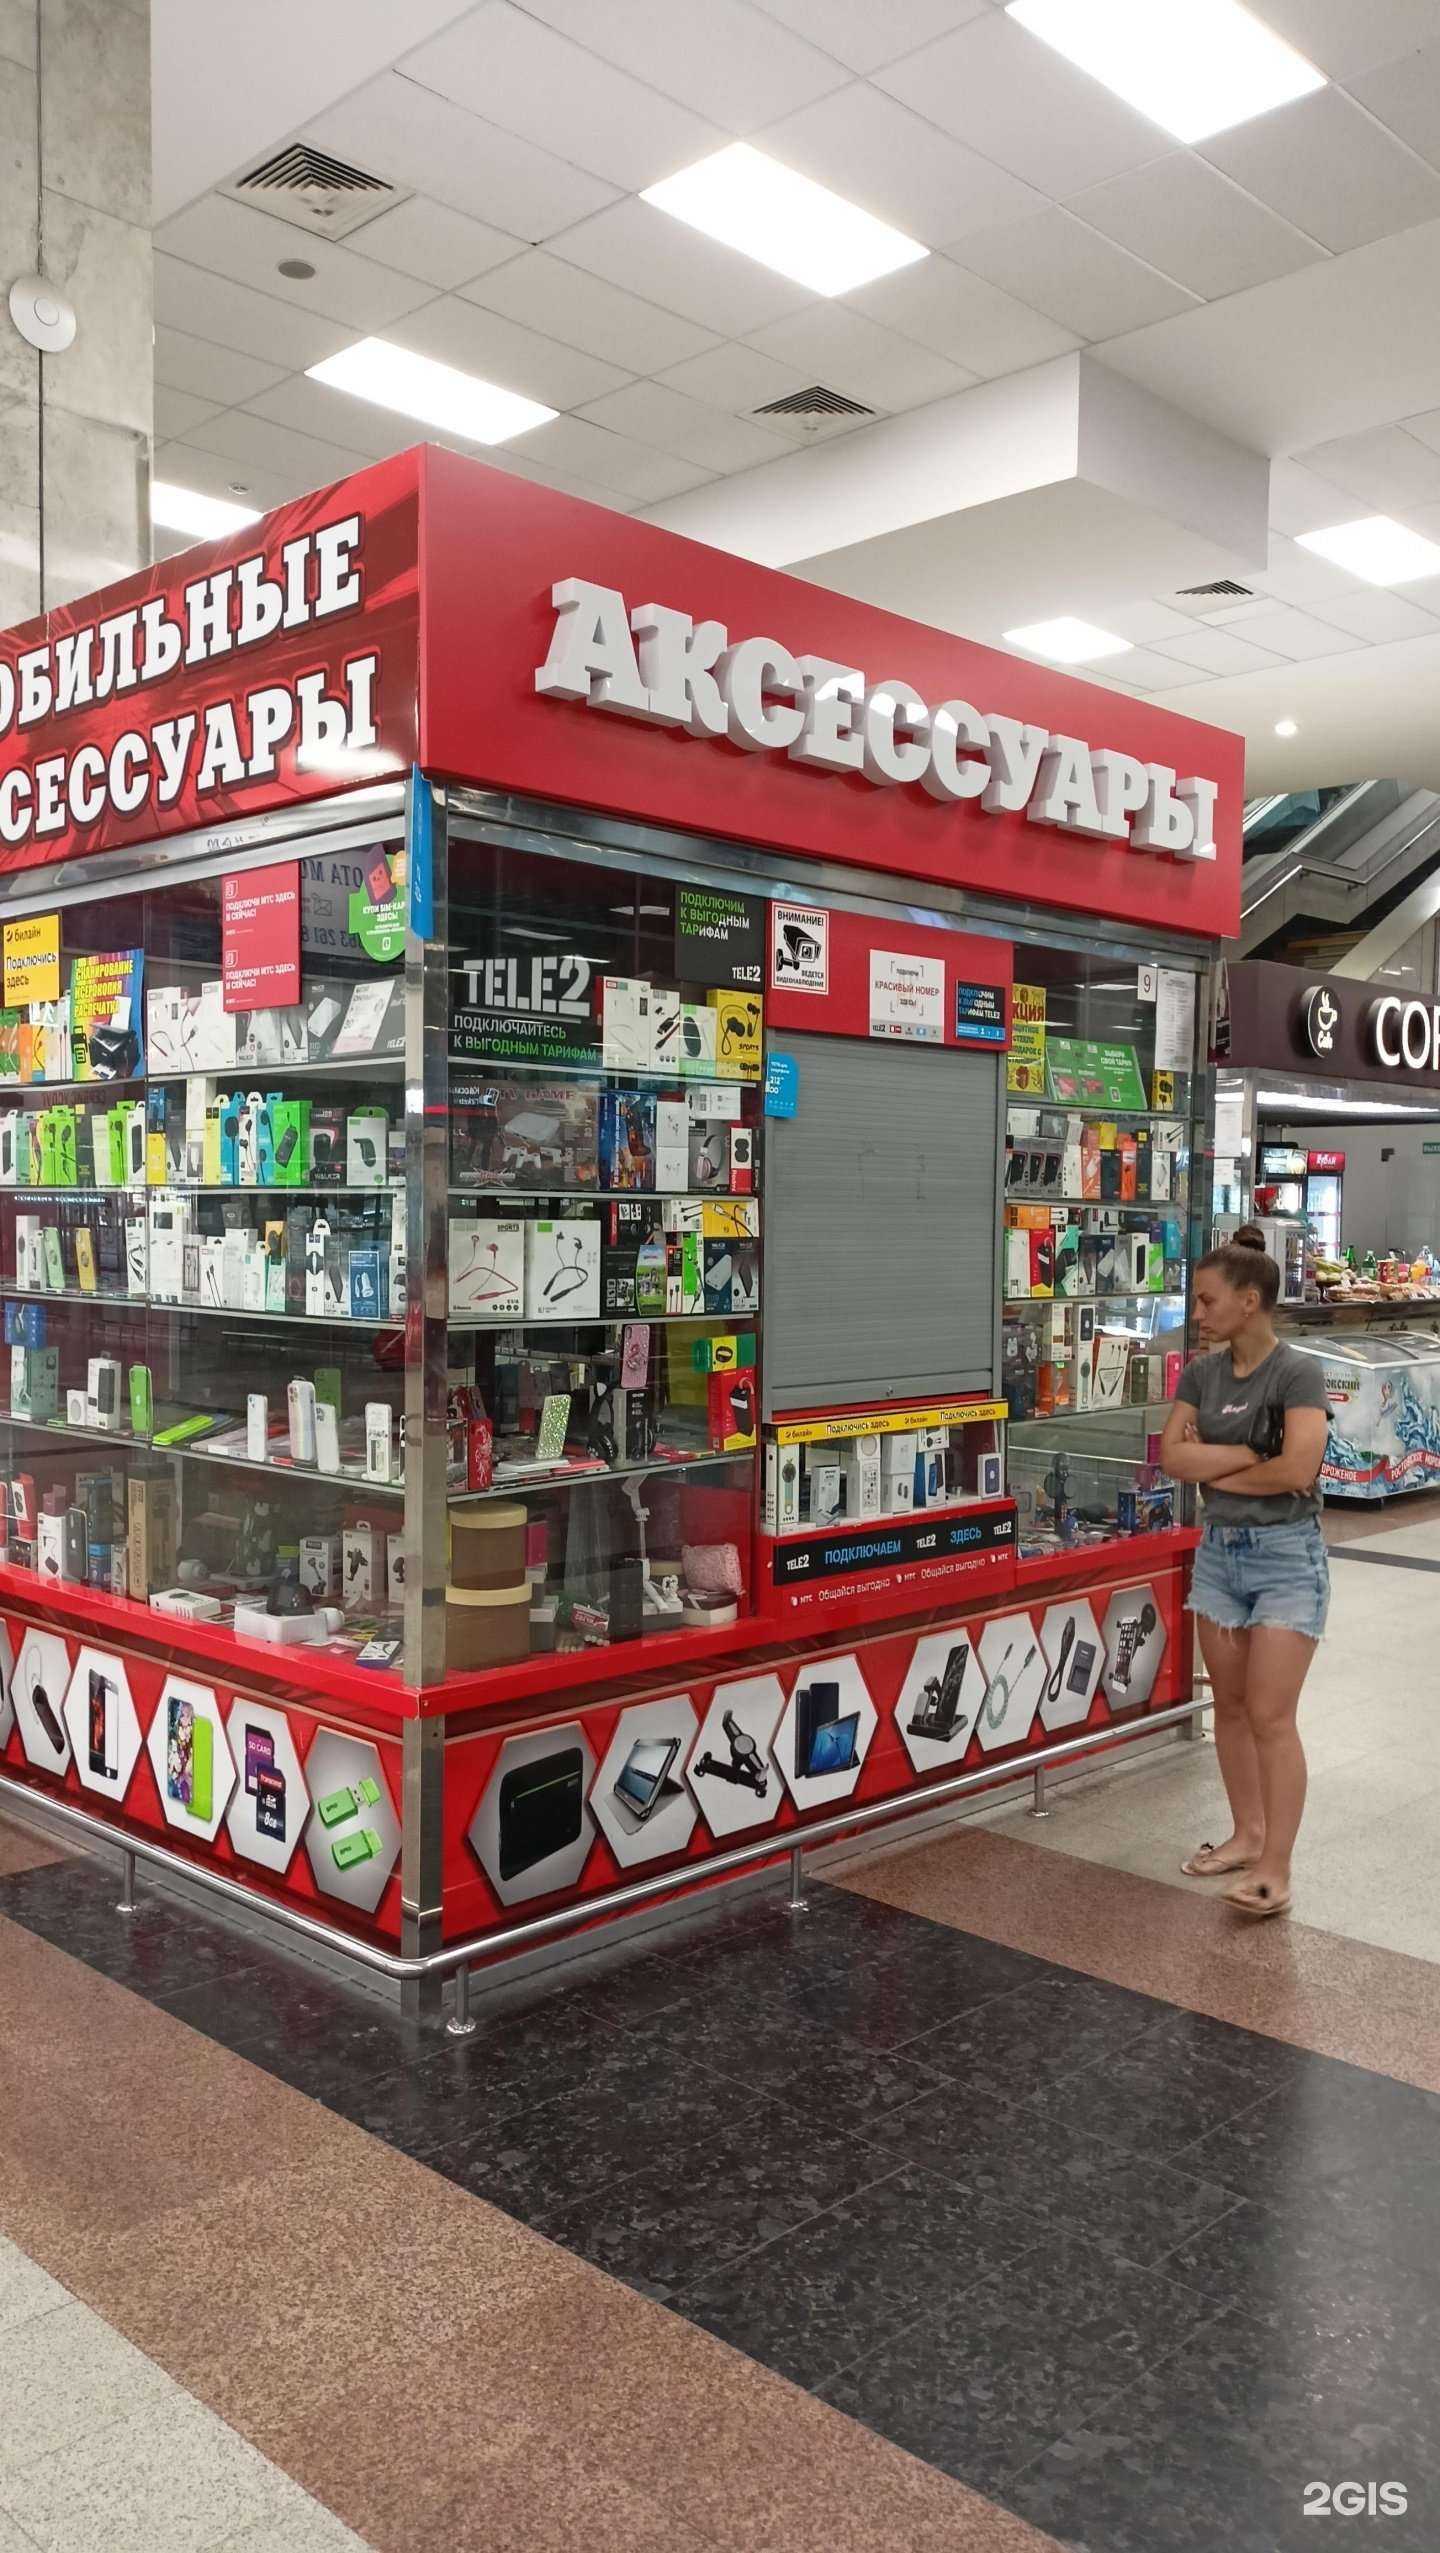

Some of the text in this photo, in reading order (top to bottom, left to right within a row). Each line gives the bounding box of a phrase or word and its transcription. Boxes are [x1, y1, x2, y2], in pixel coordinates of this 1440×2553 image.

[535, 577, 1218, 861] АКСЕССУАРЫ
[681, 892, 745, 914] ПОДКЛЮЧИМ
[680, 907, 750, 929] К ВЫГОДНЫМ
[777, 910, 824, 927] ВНИМАНИЕ!
[14, 926, 41, 942] билайн
[680, 923, 729, 941] ТАРИФАМ
[6, 952, 57, 971] Подключись
[76, 959, 133, 980] СКАНИРОВАНИЕ
[7, 974, 29, 989] здесь
[732, 966, 761, 982] TELE2
[776, 975, 824, 988] ВИДЕОНАБЛЮДЕНИЕ
[1144, 974, 1151, 993] 9
[463, 955, 591, 1017] TELE2
[874, 981, 940, 997] КРАСИВЫЙ НОМЕР
[454, 1014, 567, 1041] ПОДКЛЮЧАЙТЕСЬ
[453, 1035, 597, 1062] К ВЫГОДНЫМ ТАРИФАМ
[826, 1421, 869, 1437] Подключись
[870, 1419, 889, 1430] здесь
[786, 1521, 1012, 1571] TELE2 ПОДКЛЮЧАЕМ TELE2 ЗДЕСЬ TELE2
[818, 1586, 855, 1602] Общайся
[856, 1578, 891, 1595] выгодно
[921, 1564, 954, 1579] Общайся
[955, 1557, 986, 1574] выгодно
[256, 1744, 271, 1756] CARD
